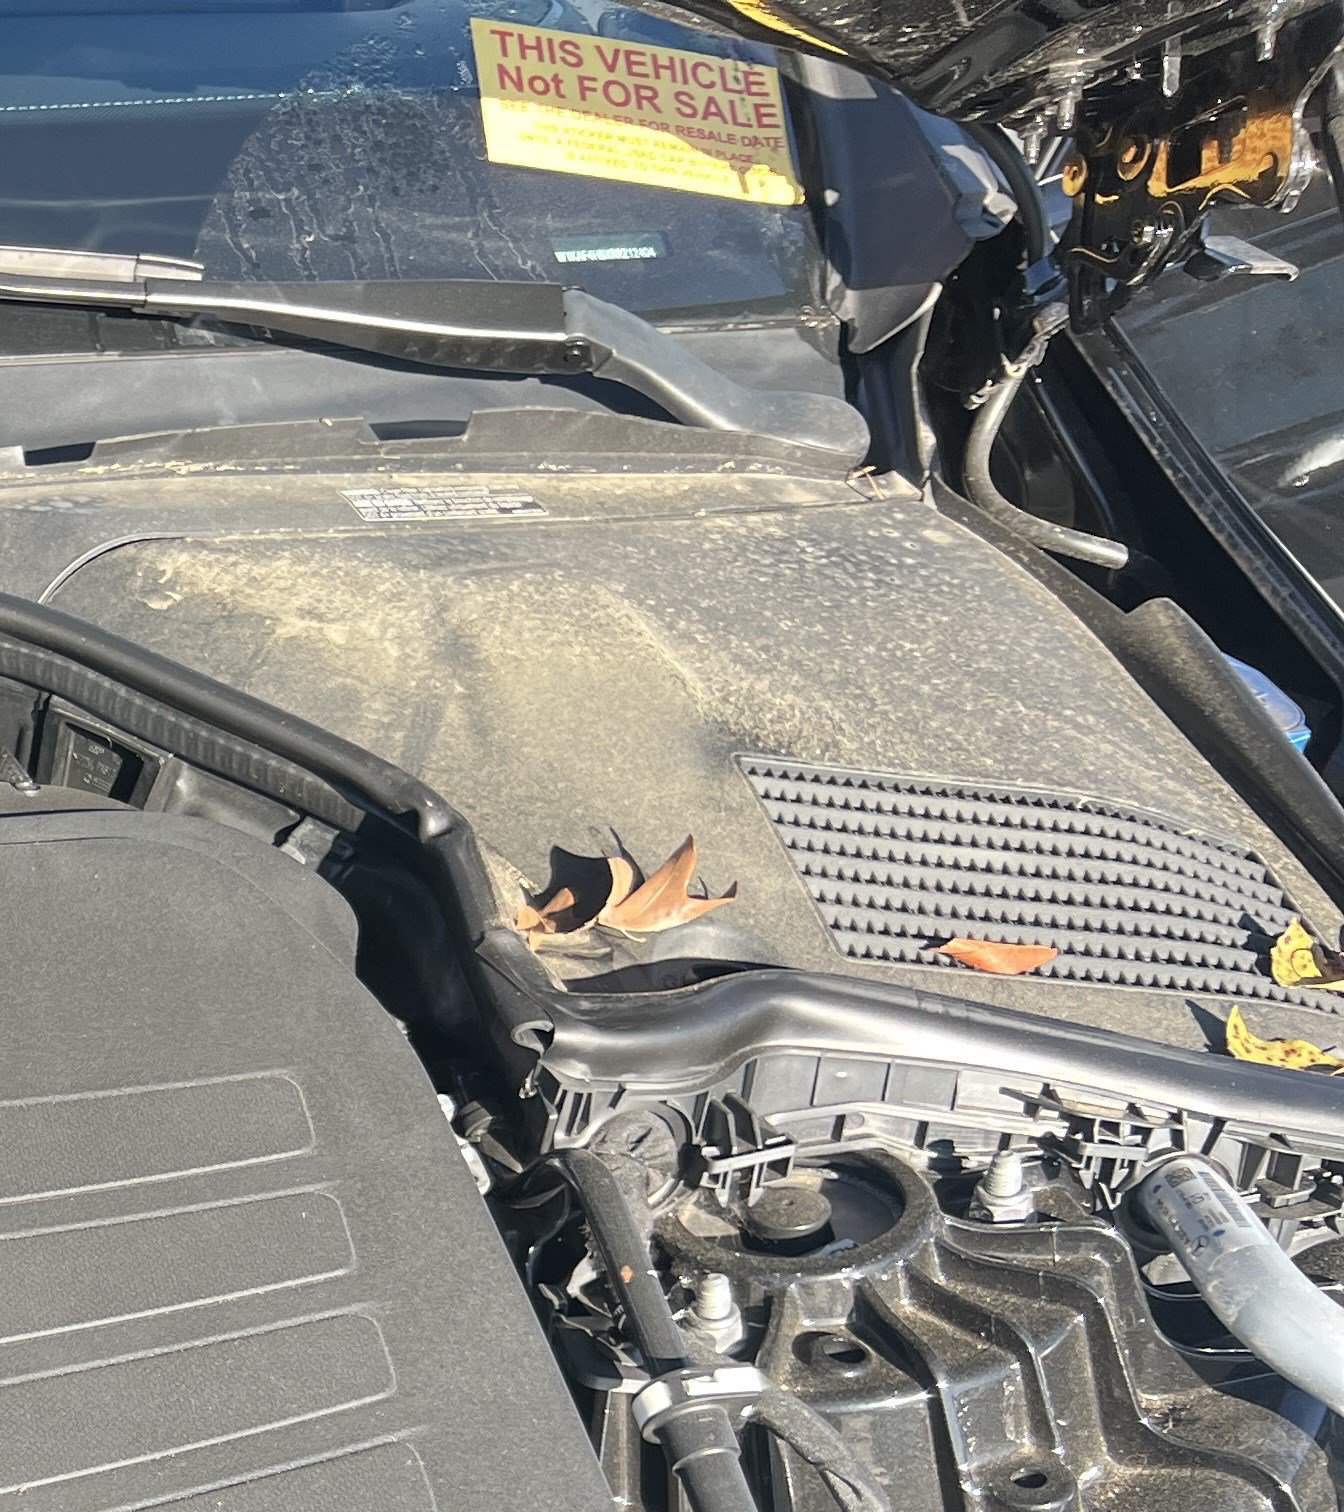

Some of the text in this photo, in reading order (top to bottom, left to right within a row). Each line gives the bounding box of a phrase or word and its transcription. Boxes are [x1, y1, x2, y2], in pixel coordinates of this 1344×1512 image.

[490, 29, 772, 97] THIS VEHICLE
[496, 63, 783, 129] Not FOR SALE
[638, 118, 670, 132] FOR
[675, 125, 737, 144] RESALE
[741, 135, 785, 149] DATE
